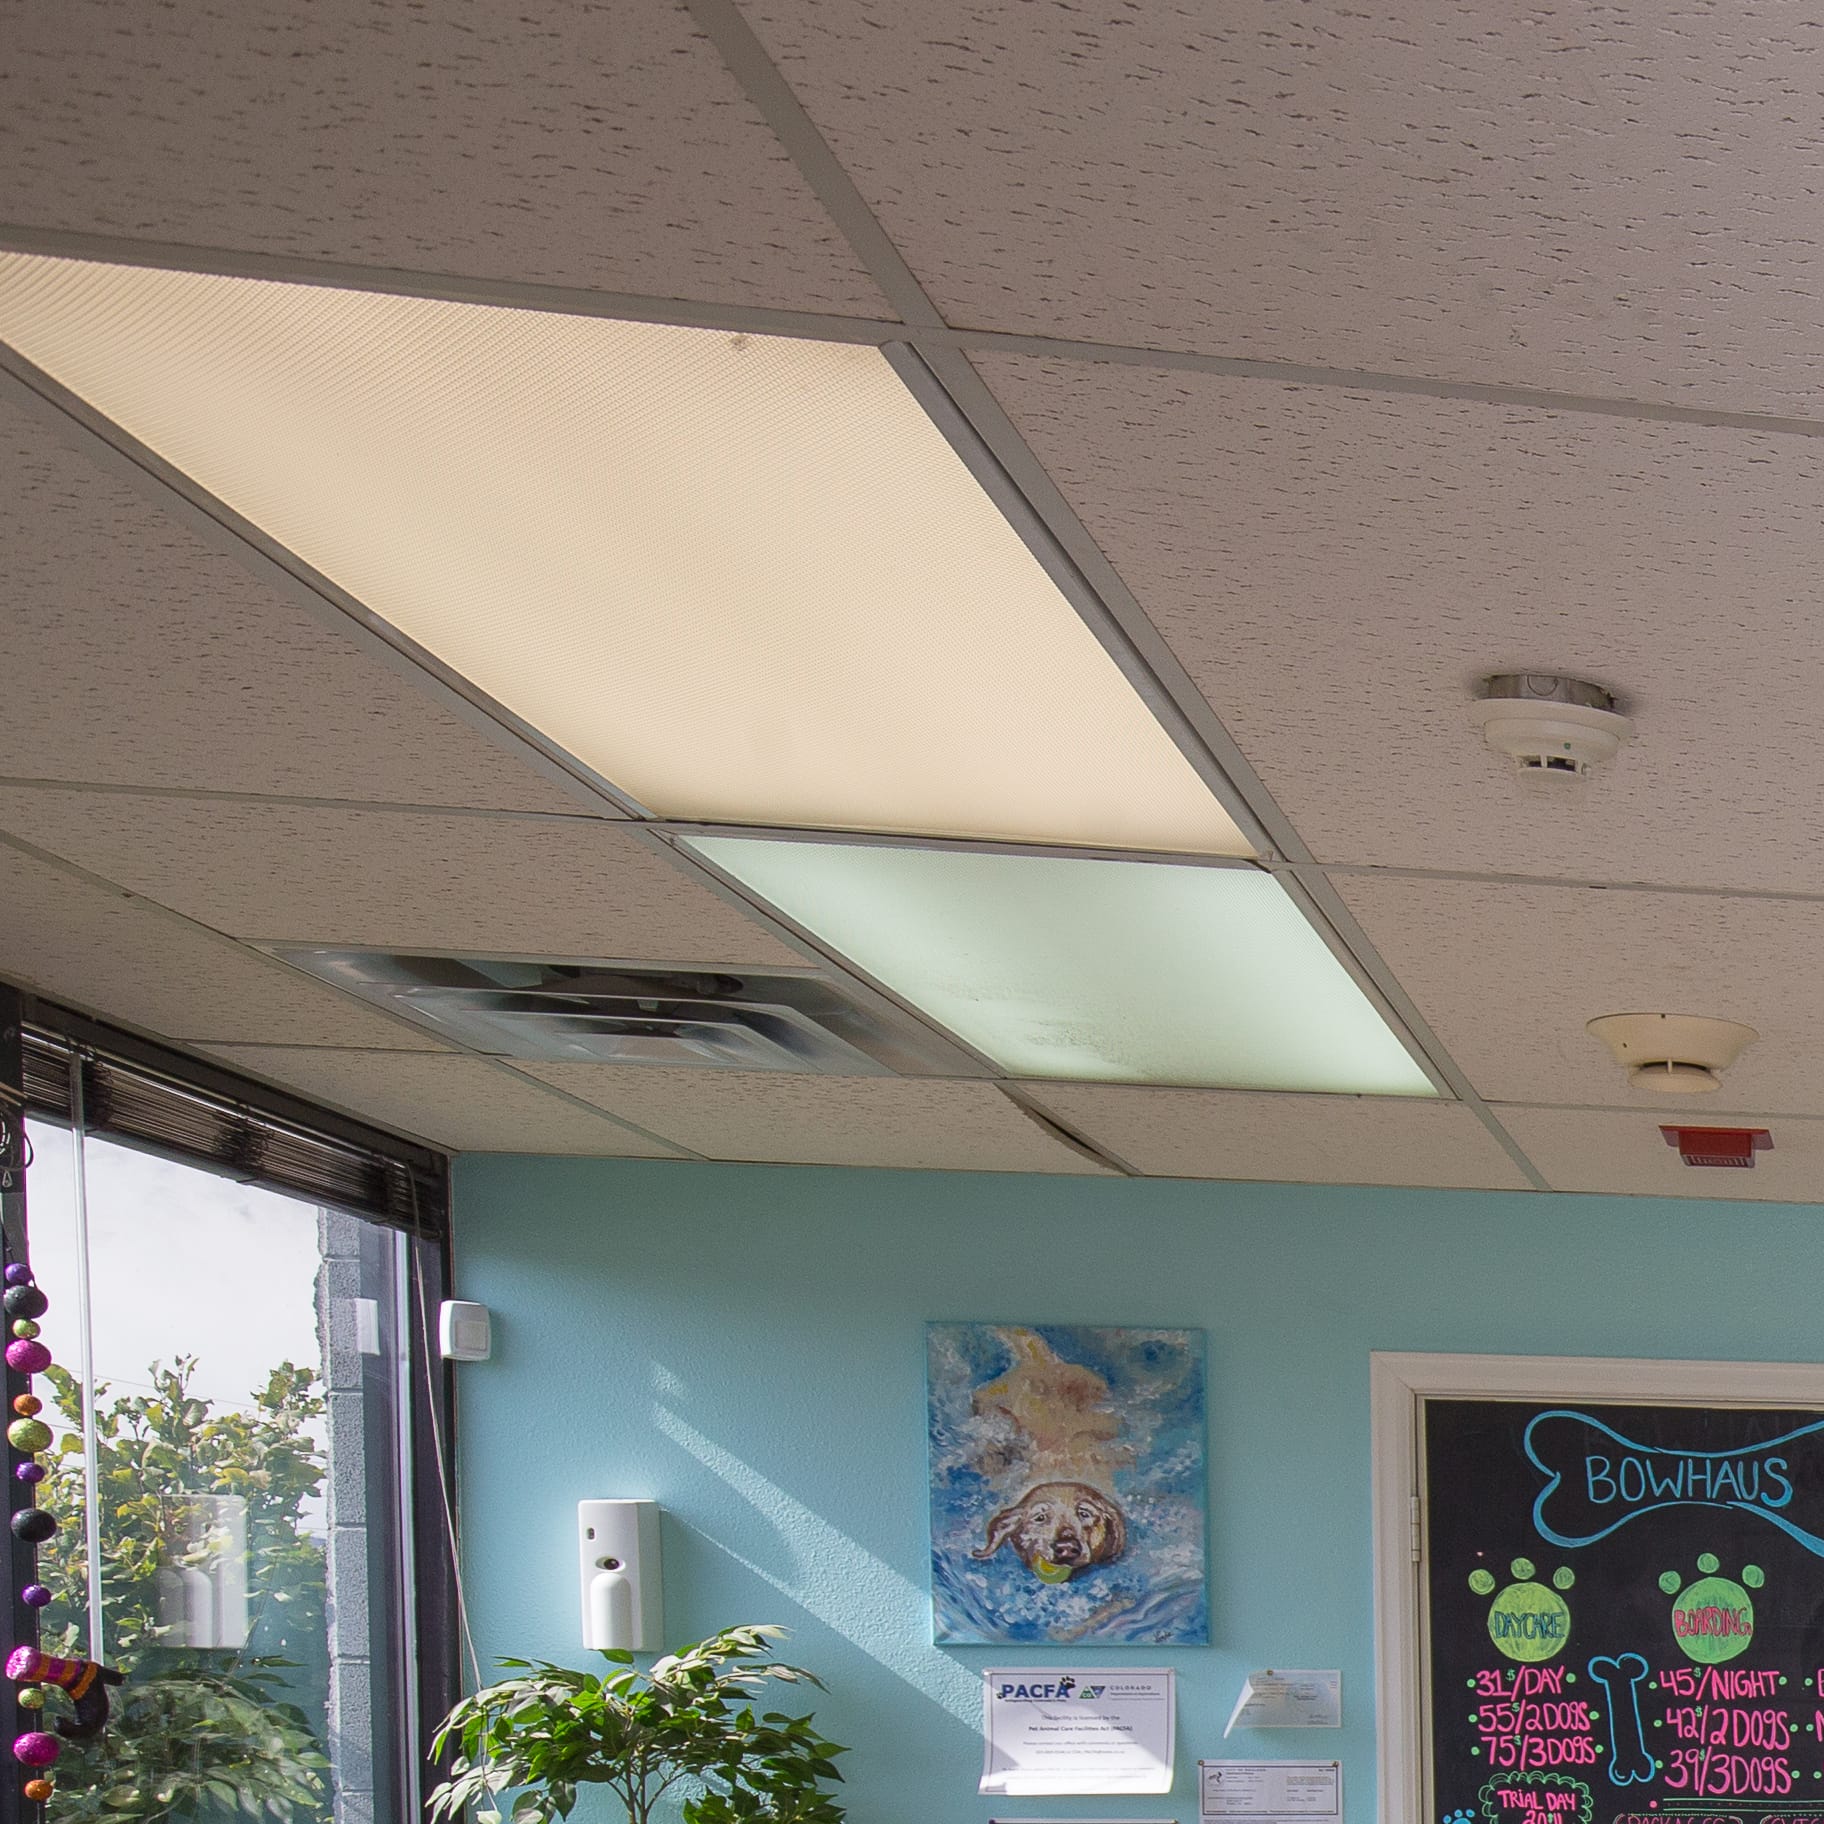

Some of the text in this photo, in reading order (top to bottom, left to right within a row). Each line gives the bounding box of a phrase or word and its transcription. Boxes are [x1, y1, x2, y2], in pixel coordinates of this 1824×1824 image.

[1584, 1454, 1794, 1508] BOWHAUS
[1494, 1611, 1565, 1639] DAYCARE
[1002, 1684, 1070, 1698] PACFA
[1546, 1792, 1576, 1811] DAY
